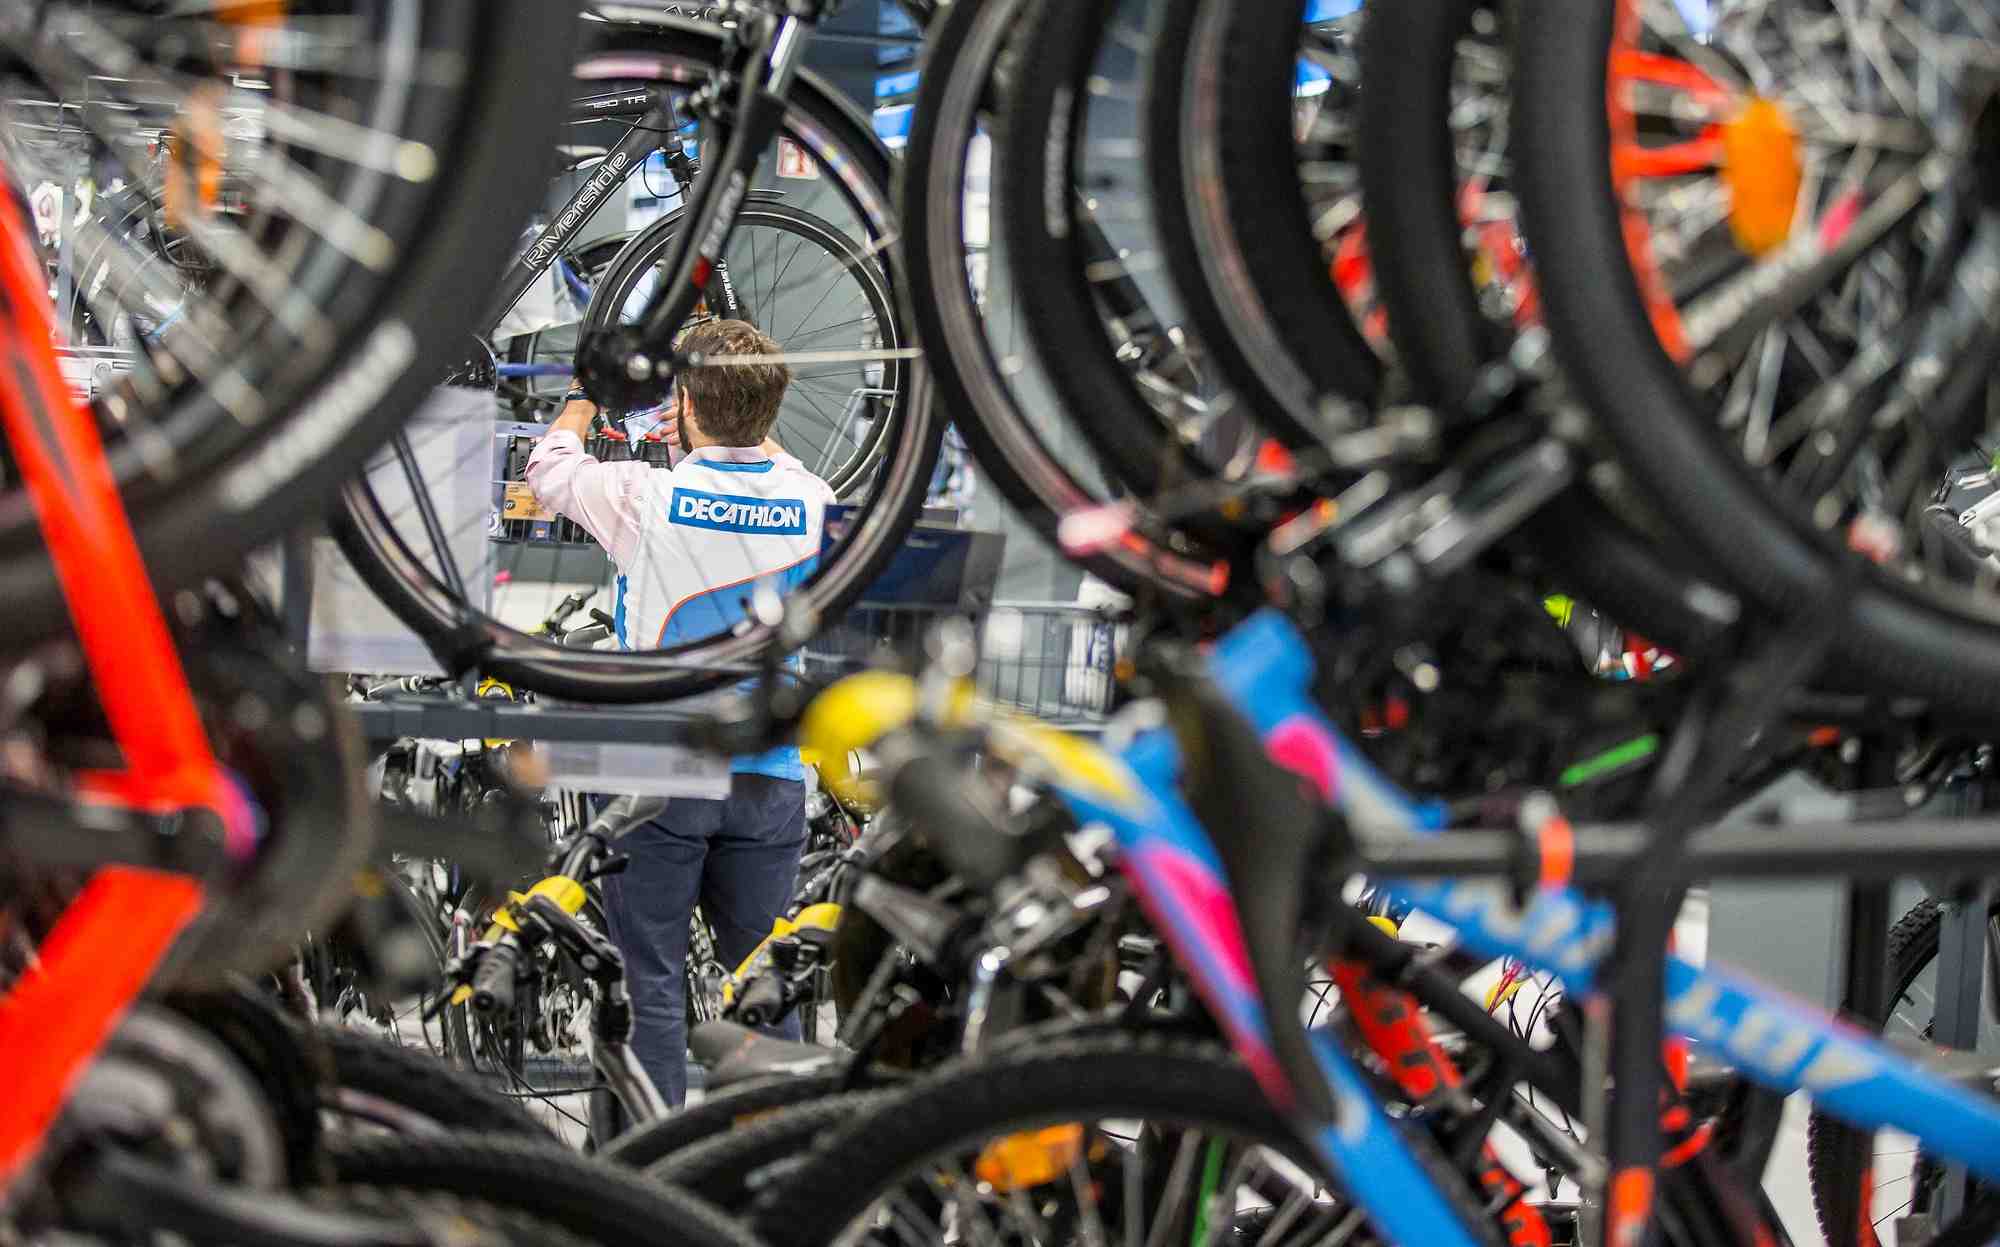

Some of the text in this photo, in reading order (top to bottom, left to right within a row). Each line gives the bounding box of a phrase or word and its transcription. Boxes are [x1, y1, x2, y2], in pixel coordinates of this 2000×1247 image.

[624, 94, 648, 105] TR
[521, 151, 631, 271] Riverside
[678, 496, 801, 528] DECATHLON
